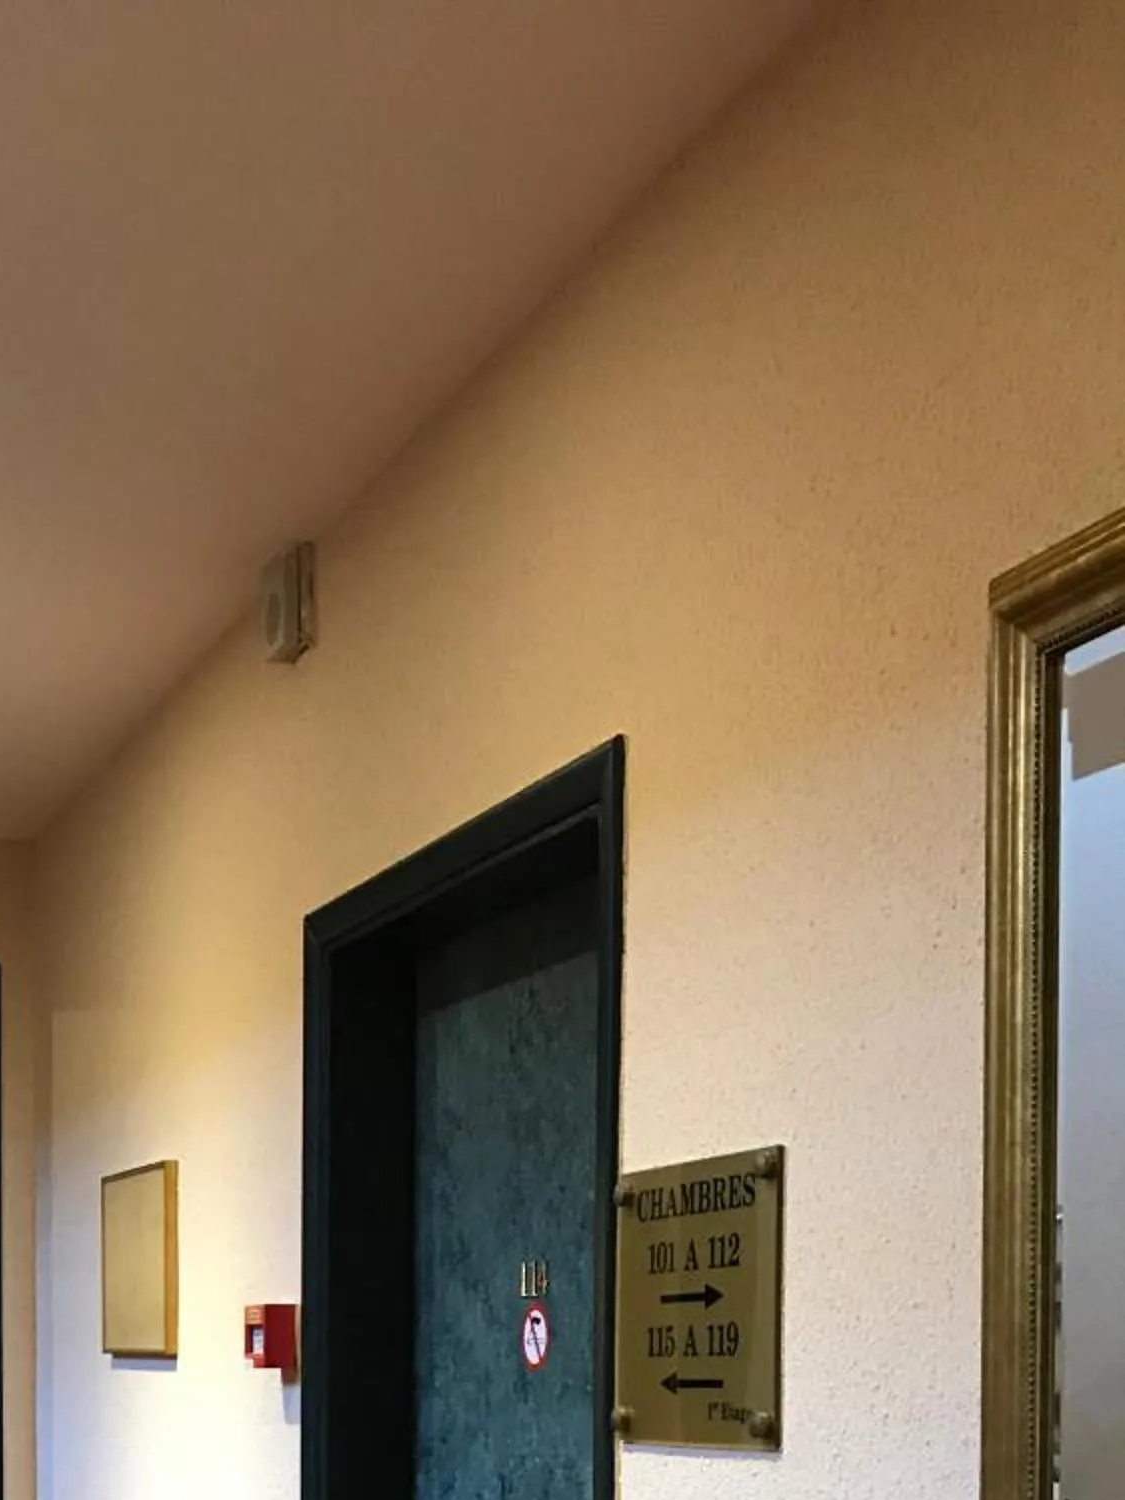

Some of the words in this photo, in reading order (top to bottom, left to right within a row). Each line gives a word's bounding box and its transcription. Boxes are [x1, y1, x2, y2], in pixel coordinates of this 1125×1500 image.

[636, 1171, 757, 1223] CHAMBRES
[647, 1242, 675, 1275] 101
[683, 1238, 699, 1271] A
[707, 1232, 741, 1269] 112
[647, 1325, 676, 1359] 115
[683, 1325, 699, 1357] A
[707, 1321, 740, 1357] 119
